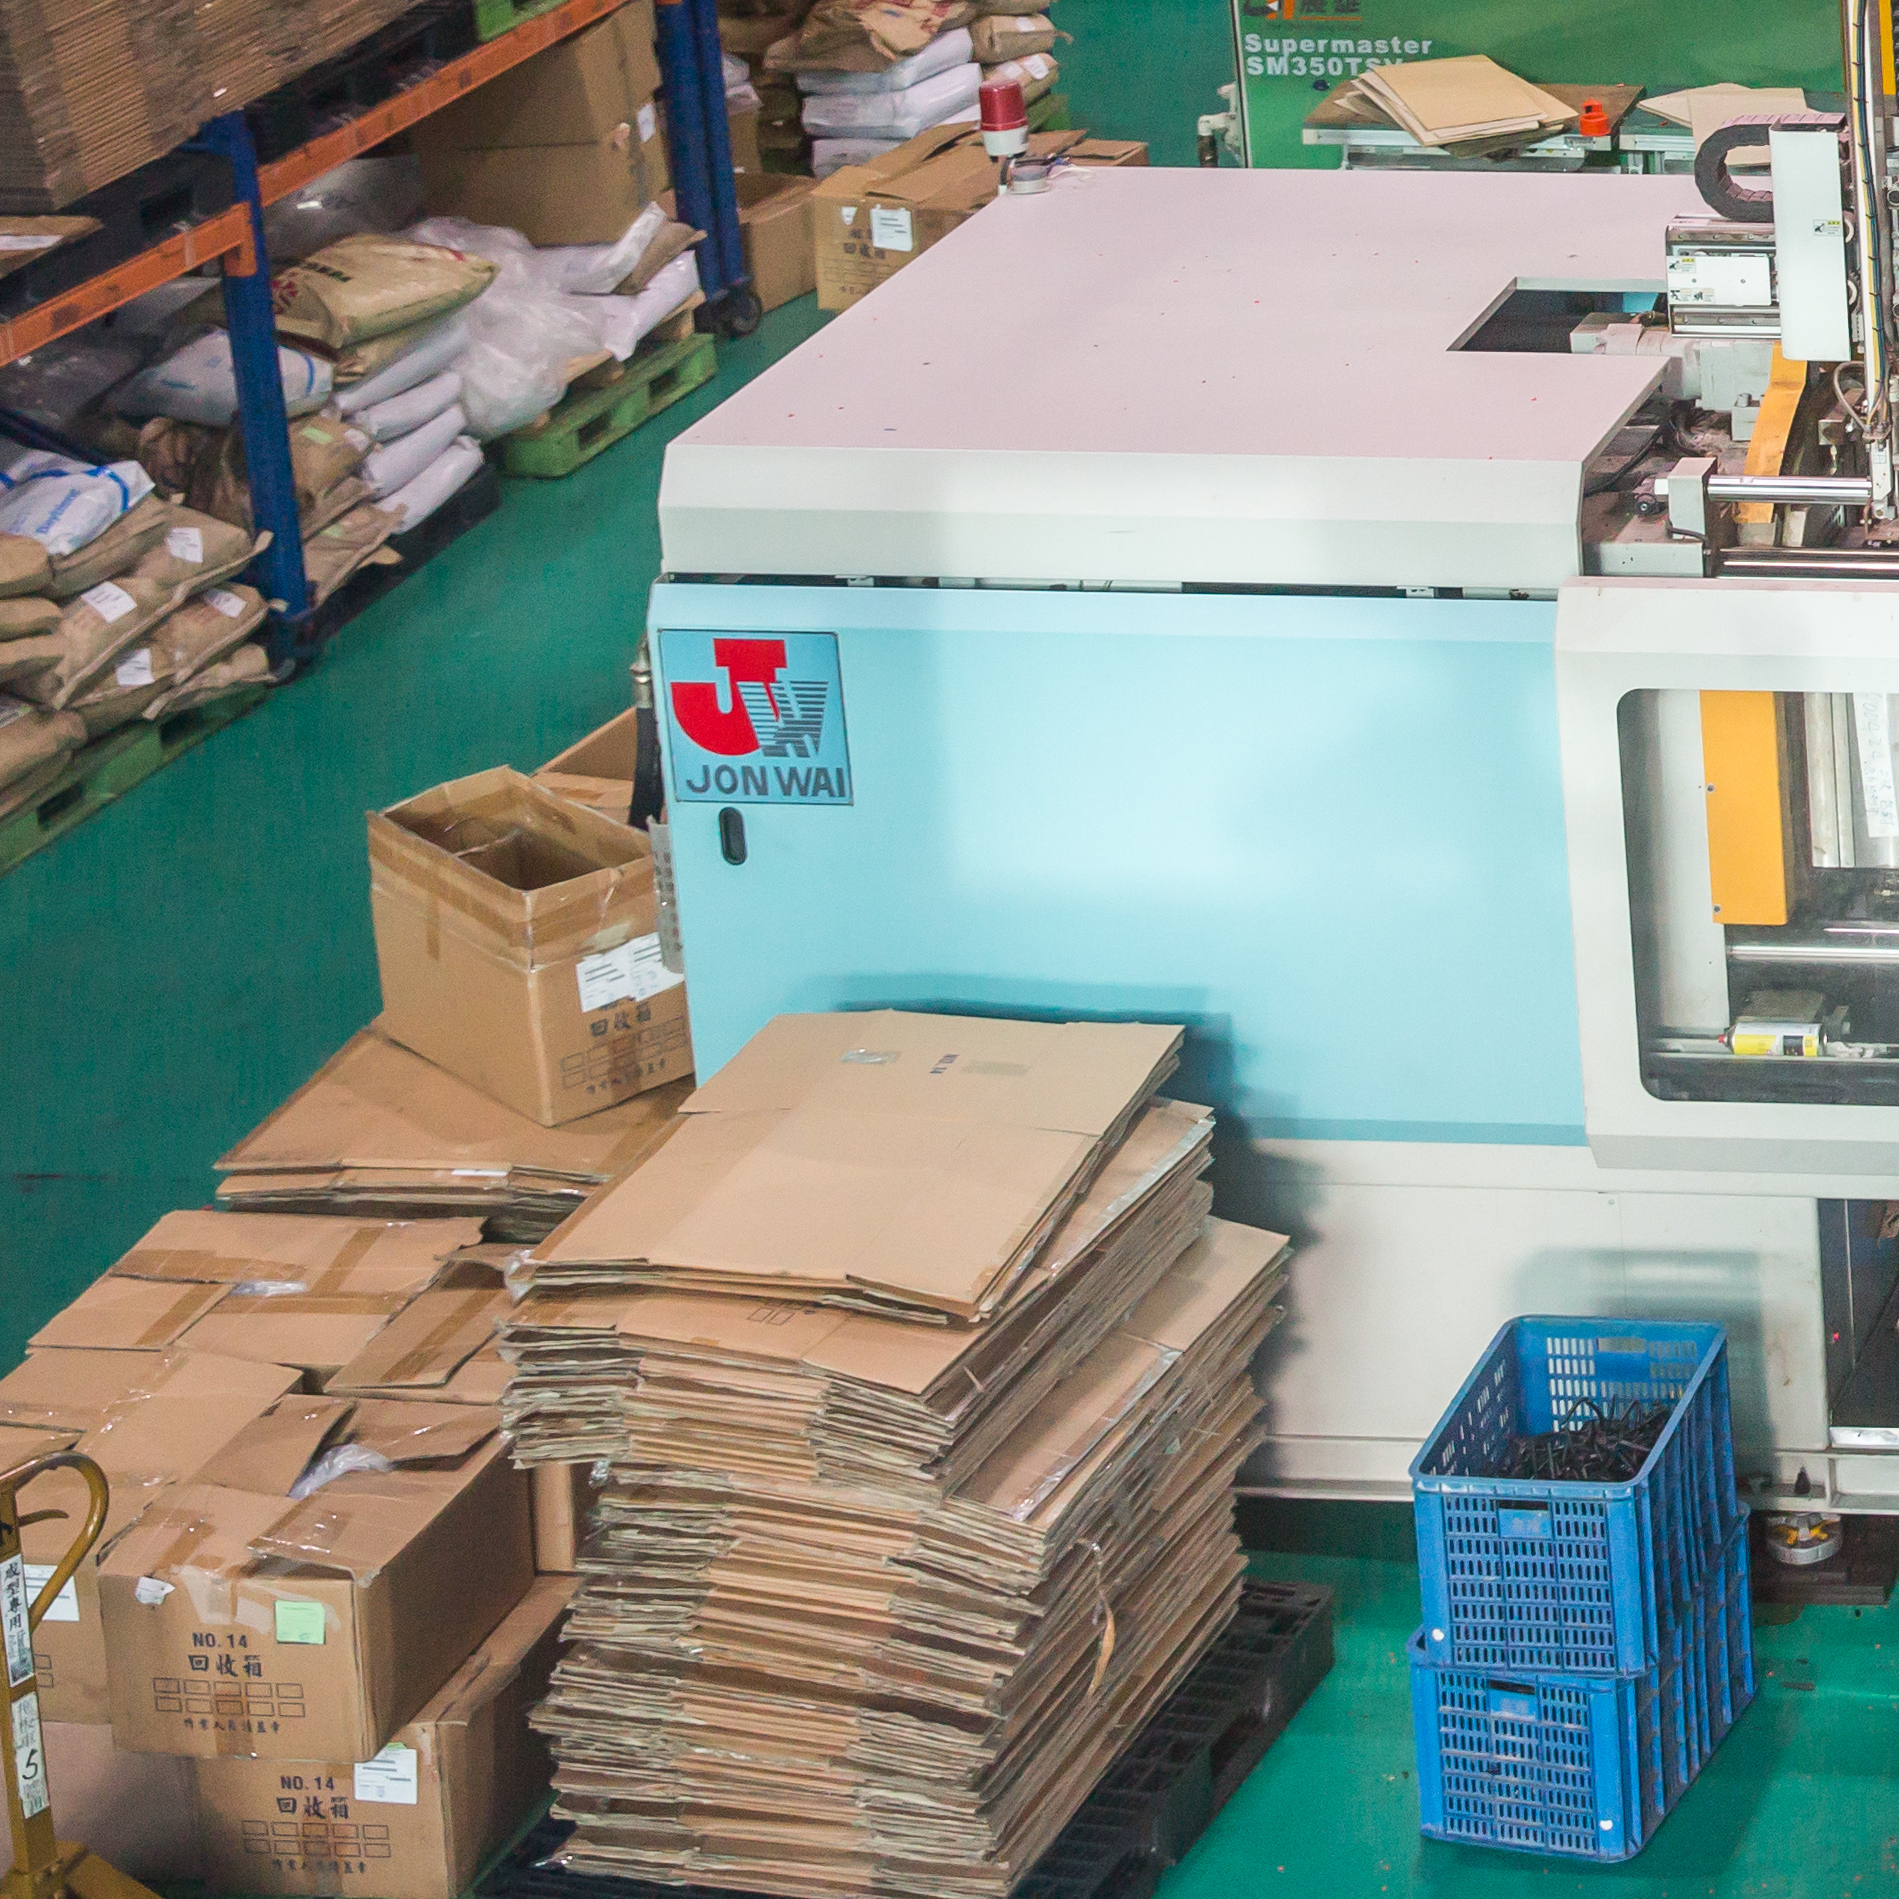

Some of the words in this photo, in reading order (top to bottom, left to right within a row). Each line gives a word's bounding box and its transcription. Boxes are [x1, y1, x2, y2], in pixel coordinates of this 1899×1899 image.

[1244, 33, 1433, 57] Supermaster
[686, 763, 769, 796] JON
[773, 765, 847, 798] WAI
[187, 1654, 263, 1678] 回收箱
[22, 1748, 39, 1780] 5
[275, 1795, 349, 1820] 回收箱
